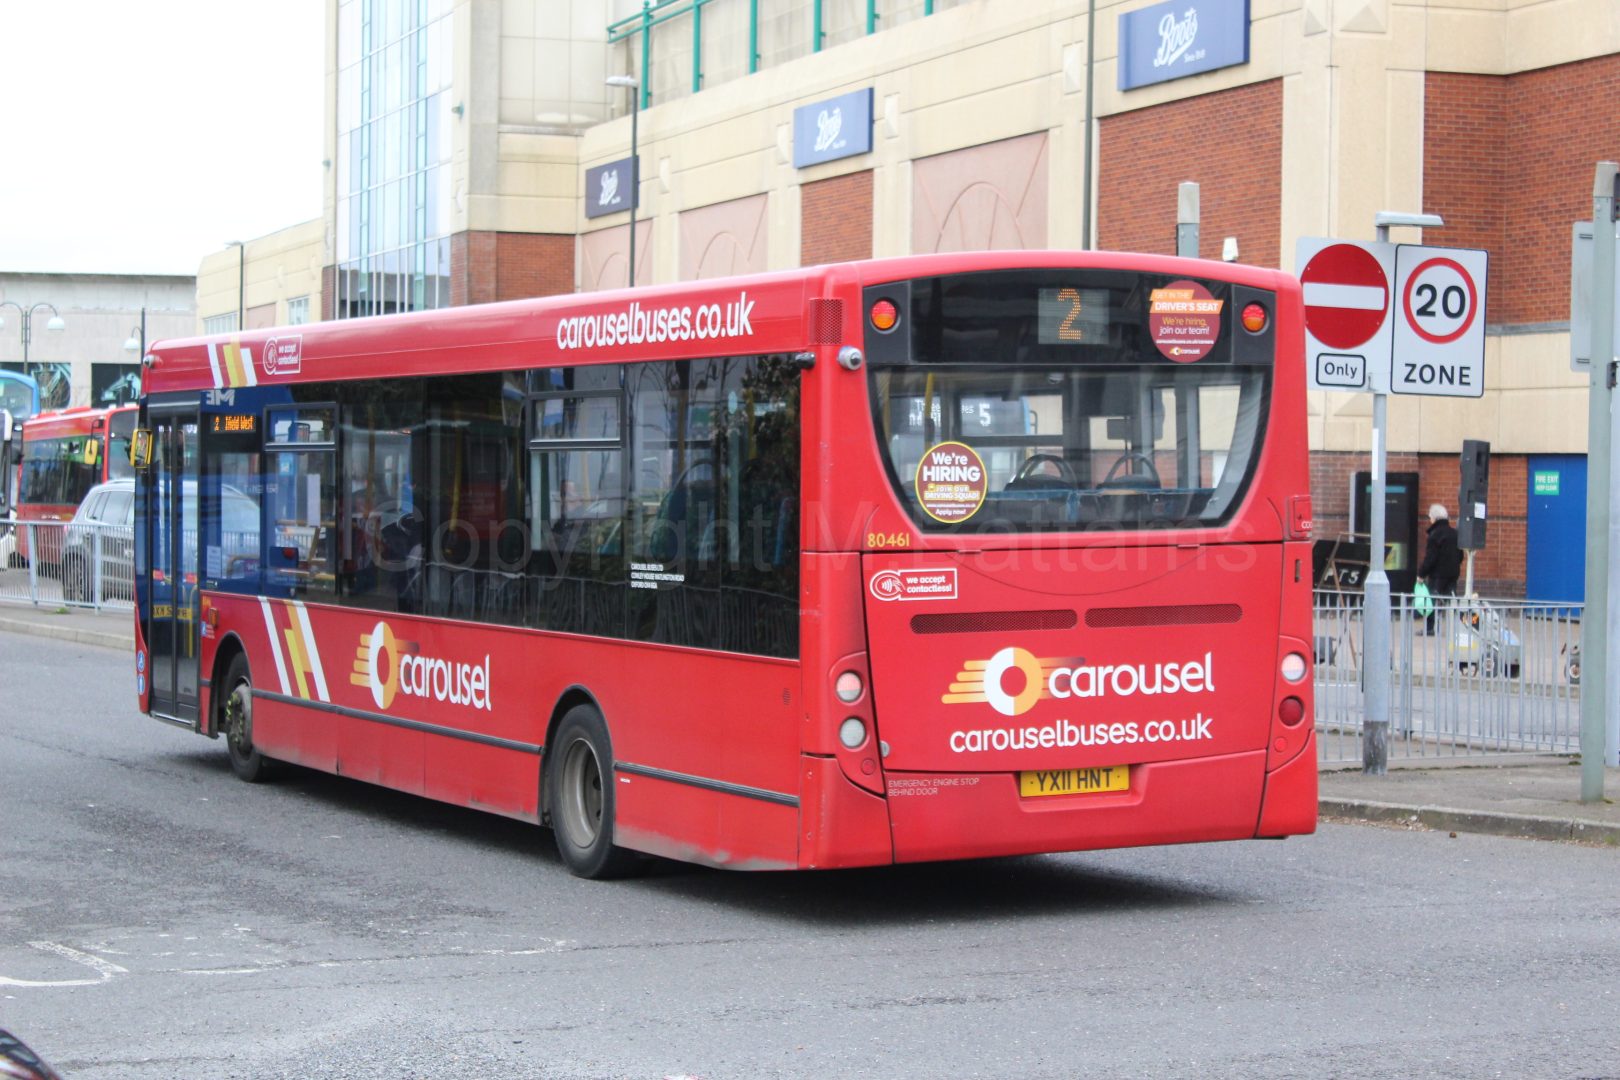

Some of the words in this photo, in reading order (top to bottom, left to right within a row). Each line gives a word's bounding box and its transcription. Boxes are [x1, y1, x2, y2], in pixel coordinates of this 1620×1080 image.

[1153, 7, 1198, 67] Boots
[814, 107, 842, 152] Boots
[1155, 302, 1195, 311] DRIVER'S
[1197, 302, 1218, 311] SEAT
[1415, 283, 1467, 320] 20
[556, 291, 756, 350] carouselbuses.co.uk
[1057, 288, 1082, 341] 2
[1162, 317, 1184, 326] We're
[1159, 326, 1173, 336] join
[1175, 327, 1187, 335] our
[1188, 326, 1210, 335] team!
[1324, 362, 1358, 381] Only
[1404, 363, 1472, 386] ZONE
[978, 402, 991, 427] 5
[931, 452, 968, 465] We're
[923, 466, 981, 482] HIRING
[867, 532, 910, 548] 80461
[906, 576, 919, 584] we
[920, 575, 946, 585] accept
[906, 584, 952, 594] contactless!
[400, 653, 492, 712] carousel
[1048, 651, 1215, 700] carousel
[949, 713, 1213, 754] carouselbuses.co.uk
[888, 779, 932, 788] EMERGENCY
[933, 778, 959, 787] ENGINE
[960, 777, 980, 785] STOP
[1036, 771, 1071, 792] YX11
[1077, 768, 1113, 790] HNT
[888, 788, 915, 797] BEHIND
[916, 787, 938, 796] DOOR
